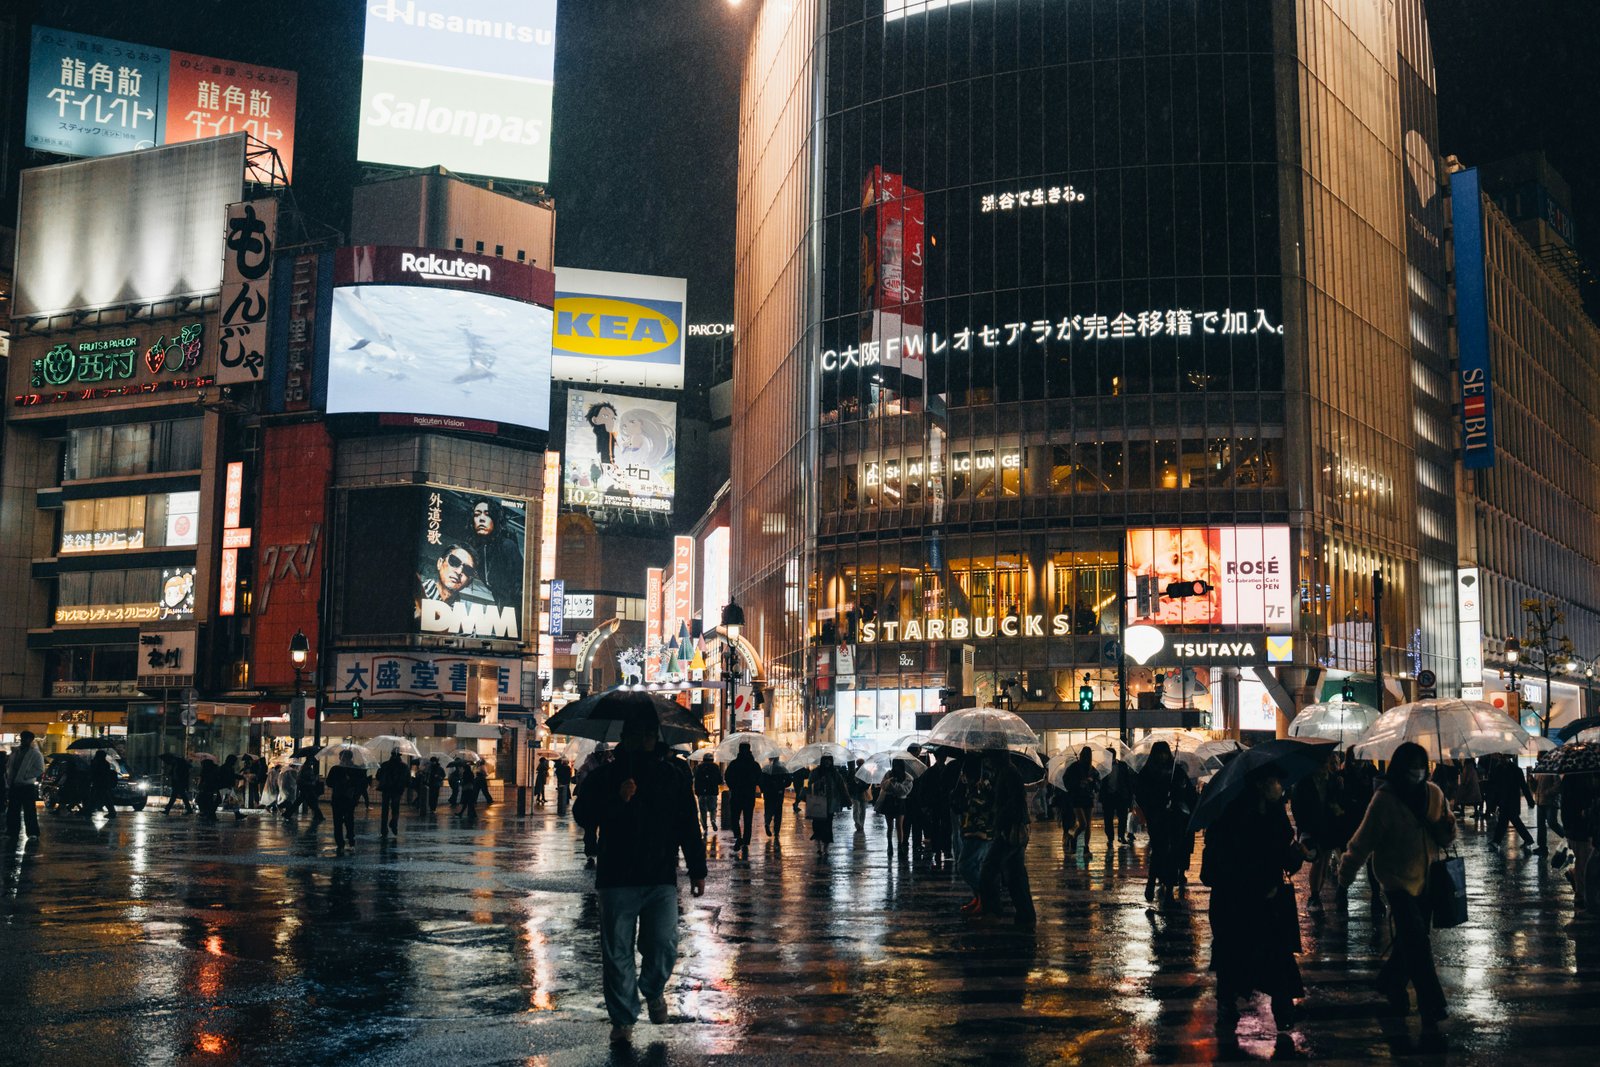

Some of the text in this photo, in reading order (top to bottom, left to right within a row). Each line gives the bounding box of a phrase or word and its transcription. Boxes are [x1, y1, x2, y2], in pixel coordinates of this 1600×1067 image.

[369, 0, 552, 46] Hisamitsu
[61, 57, 142, 97] 龍角散
[46, 87, 154, 129] ダイレクト
[198, 80, 272, 118] 龍角散
[366, 92, 543, 146] Salonpas
[981, 186, 1085, 212] 渋谷で生きる。
[402, 253, 491, 281] Rakuten
[219, 205, 271, 378] もんじゃ
[285, 258, 313, 402] 三千里薬品
[688, 323, 724, 336] PARCO
[78, 350, 136, 382] 西村
[413, 416, 465, 427] Rakuten Vision
[1462, 368, 1487, 451] SEIBU
[427, 493, 443, 545] 外道の歌
[1227, 556, 1279, 575] ROSÉ
[421, 598, 519, 638] DMM
[863, 614, 1070, 642] STARBUCKS
[1265, 605, 1285, 618] 7F
[1174, 643, 1255, 657] TSUTAYA
